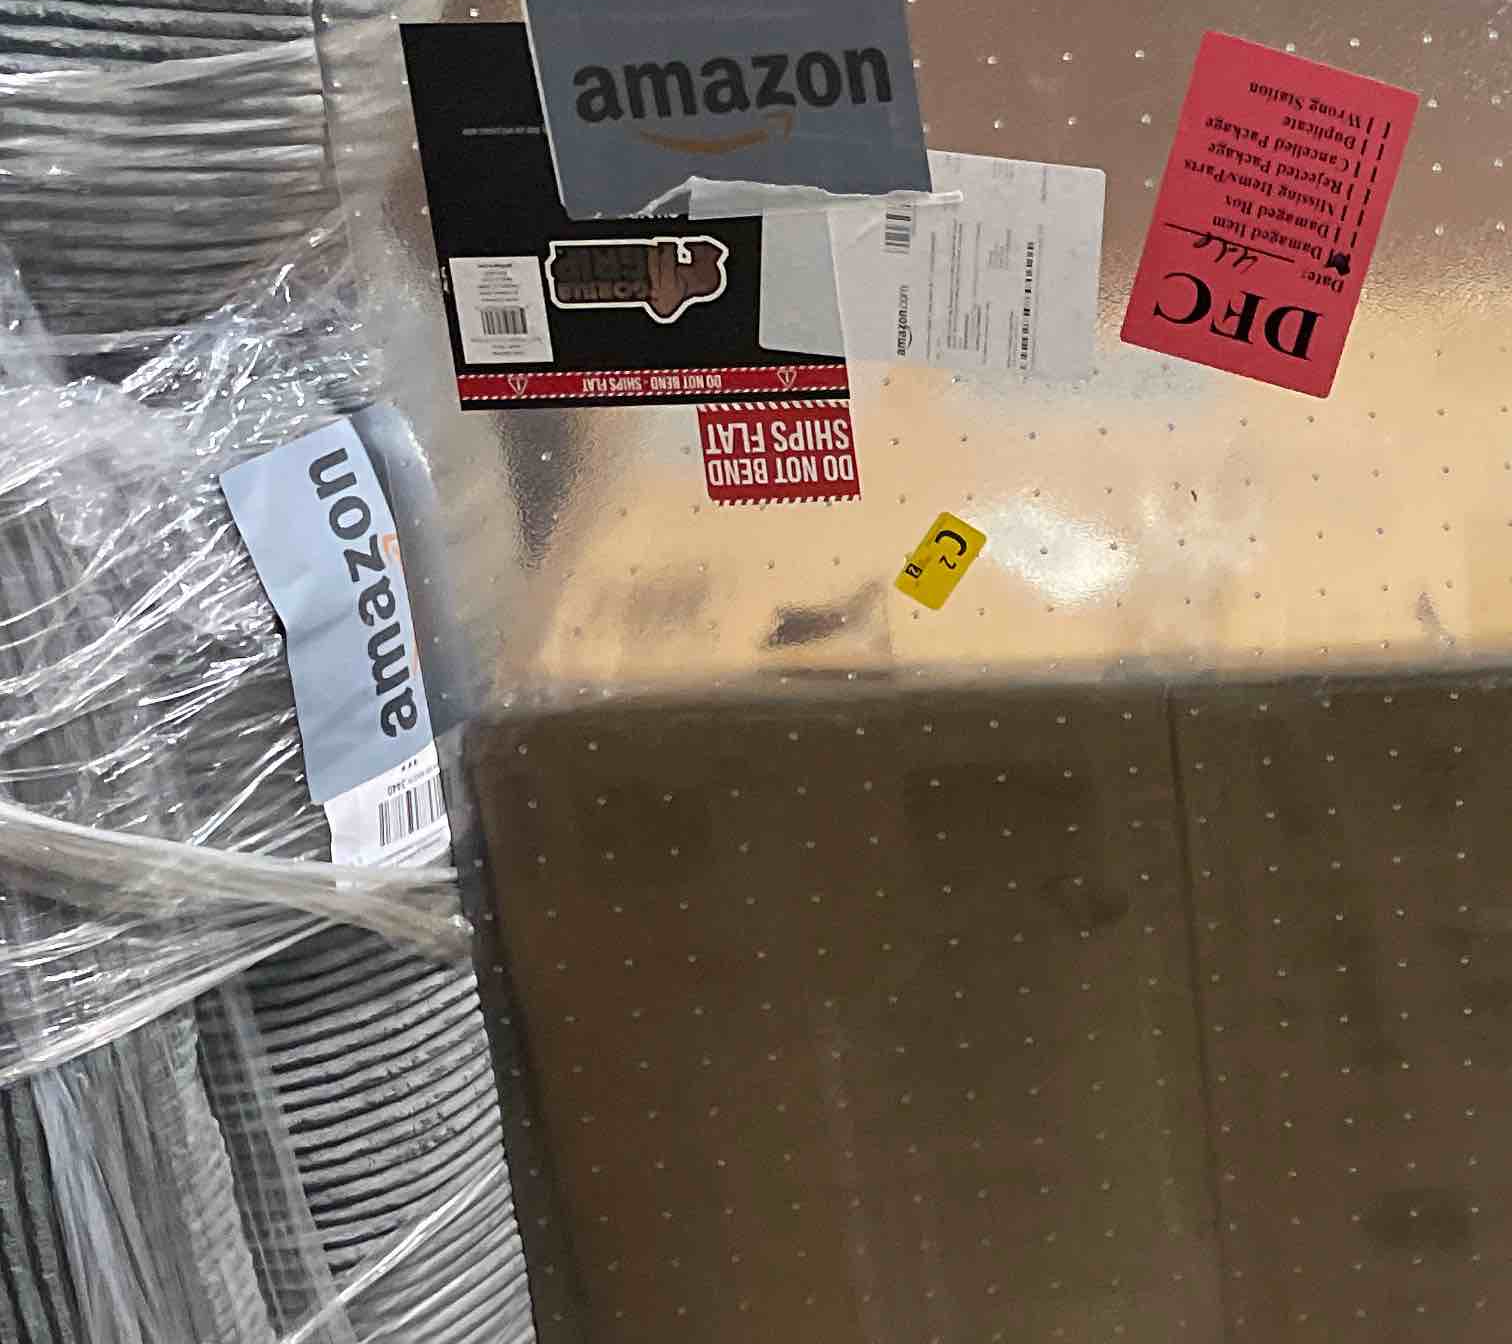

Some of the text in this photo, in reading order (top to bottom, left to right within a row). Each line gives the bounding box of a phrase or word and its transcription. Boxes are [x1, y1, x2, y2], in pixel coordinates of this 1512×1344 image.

[572, 45, 893, 124] amazon
[1249, 82, 1361, 129] Wrong Station
[1205, 116, 1350, 172] Cancelled Package
[1282, 116, 1357, 150] Duplicate
[1207, 142, 1344, 195] Rejected Package
[1225, 194, 1331, 239] Damaged Box
[1277, 185, 1335, 217] Missing
[1212, 215, 1324, 261] Damaged Item
[1301, 270, 1346, 293] Date:
[1152, 271, 1324, 361] DFC
[581, 376, 608, 392] FLAT
[609, 376, 643, 392] SHIPS
[651, 375, 681, 391] BEND
[682, 374, 704, 390] NOT
[705, 373, 723, 390] DO
[705, 418, 850, 455] SHIPS FLAT
[707, 454, 855, 486] DO NOT BEND
[308, 447, 419, 739] amazon
